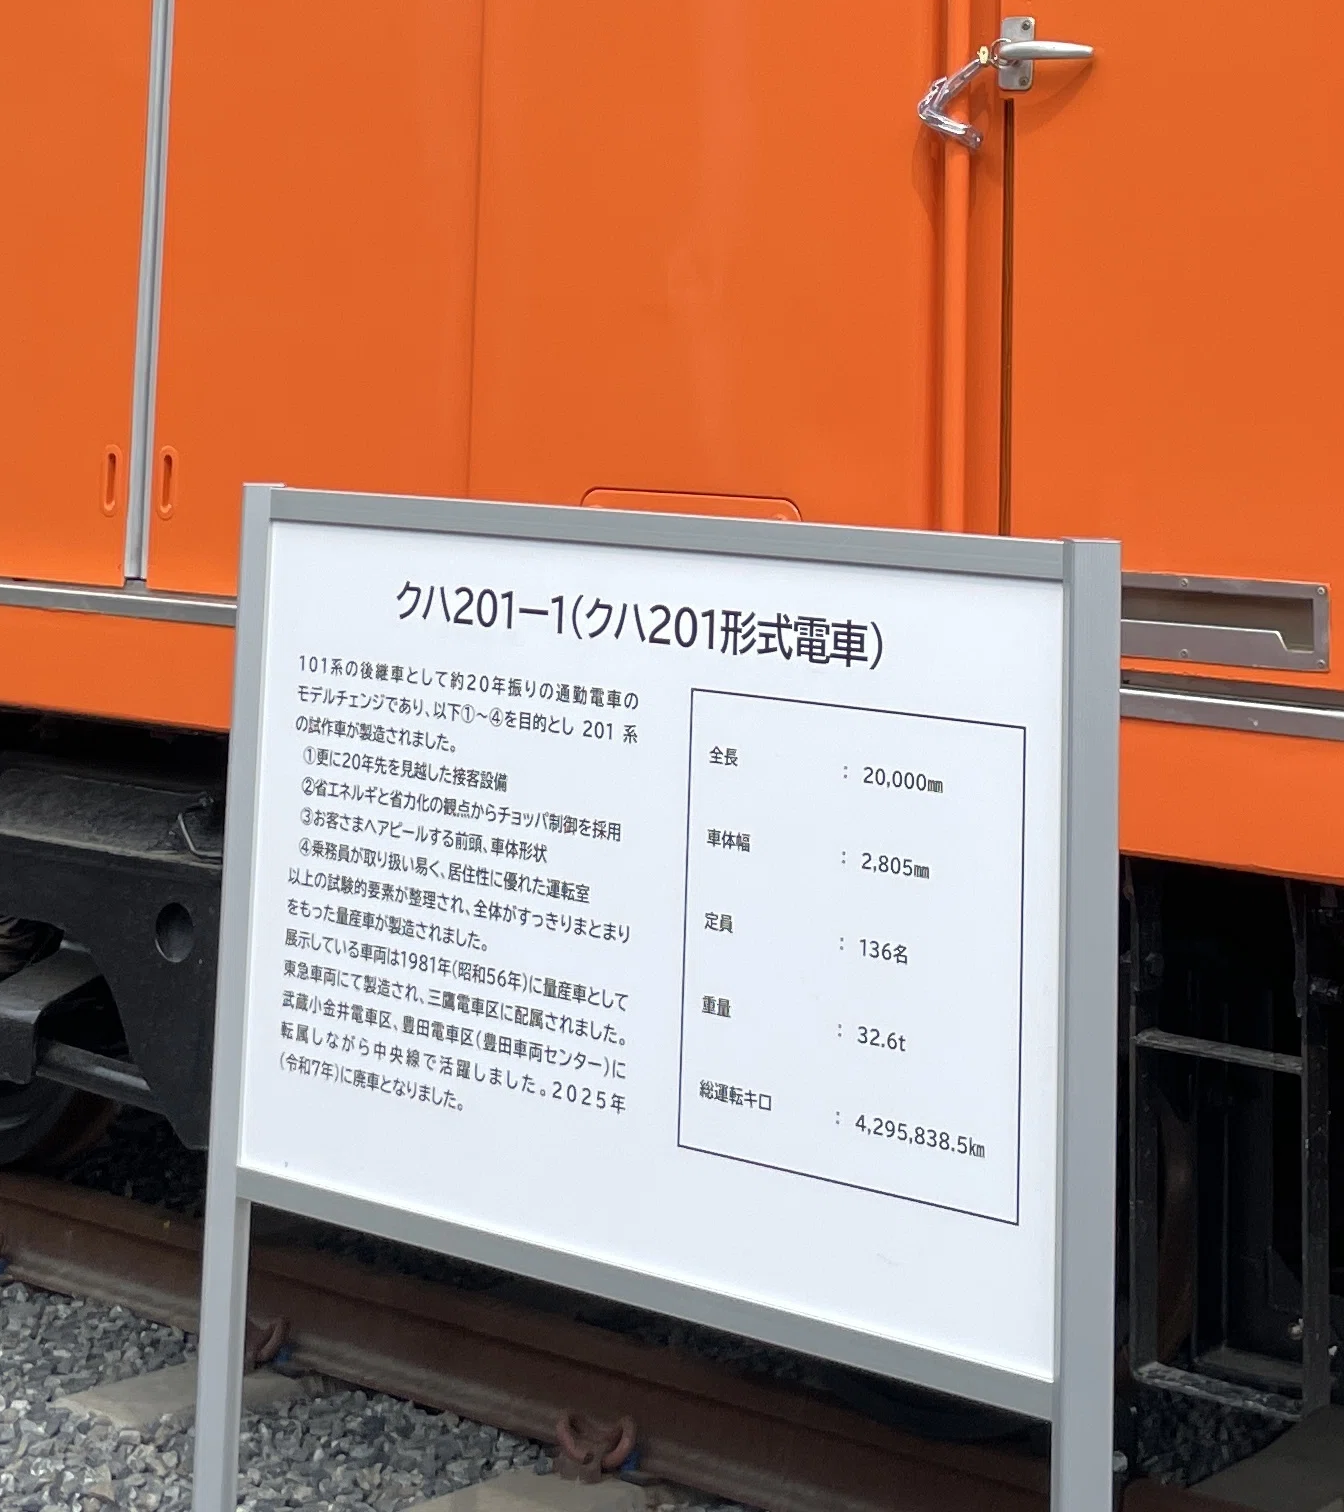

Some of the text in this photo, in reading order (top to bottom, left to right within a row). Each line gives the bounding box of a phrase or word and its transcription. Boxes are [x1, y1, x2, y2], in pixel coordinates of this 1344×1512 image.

[299, 655, 639, 710] 101系の後継車として約20年振りの通勤電車の
[296, 715, 456, 754] の試作車が製造されました。
[582, 719, 614, 741] 201
[623, 724, 638, 745] 系
[709, 746, 738, 766] 全長
[706, 829, 751, 852] 車体幅
[287, 899, 488, 952] をもった量産車が製造されました。
[288, 867, 630, 943] 以上の試験的要素が整理され、全体がすっきりまとまり
[704, 912, 733, 934] 定員
[859, 939, 908, 965] 136名
[284, 960, 626, 1046] 東急車両にて製造され、三鷹電車区に配属されました。
[702, 995, 731, 1018] 重量
[857, 1026, 906, 1052] 32.6t
[699, 1079, 772, 1111] 総運転キロ
